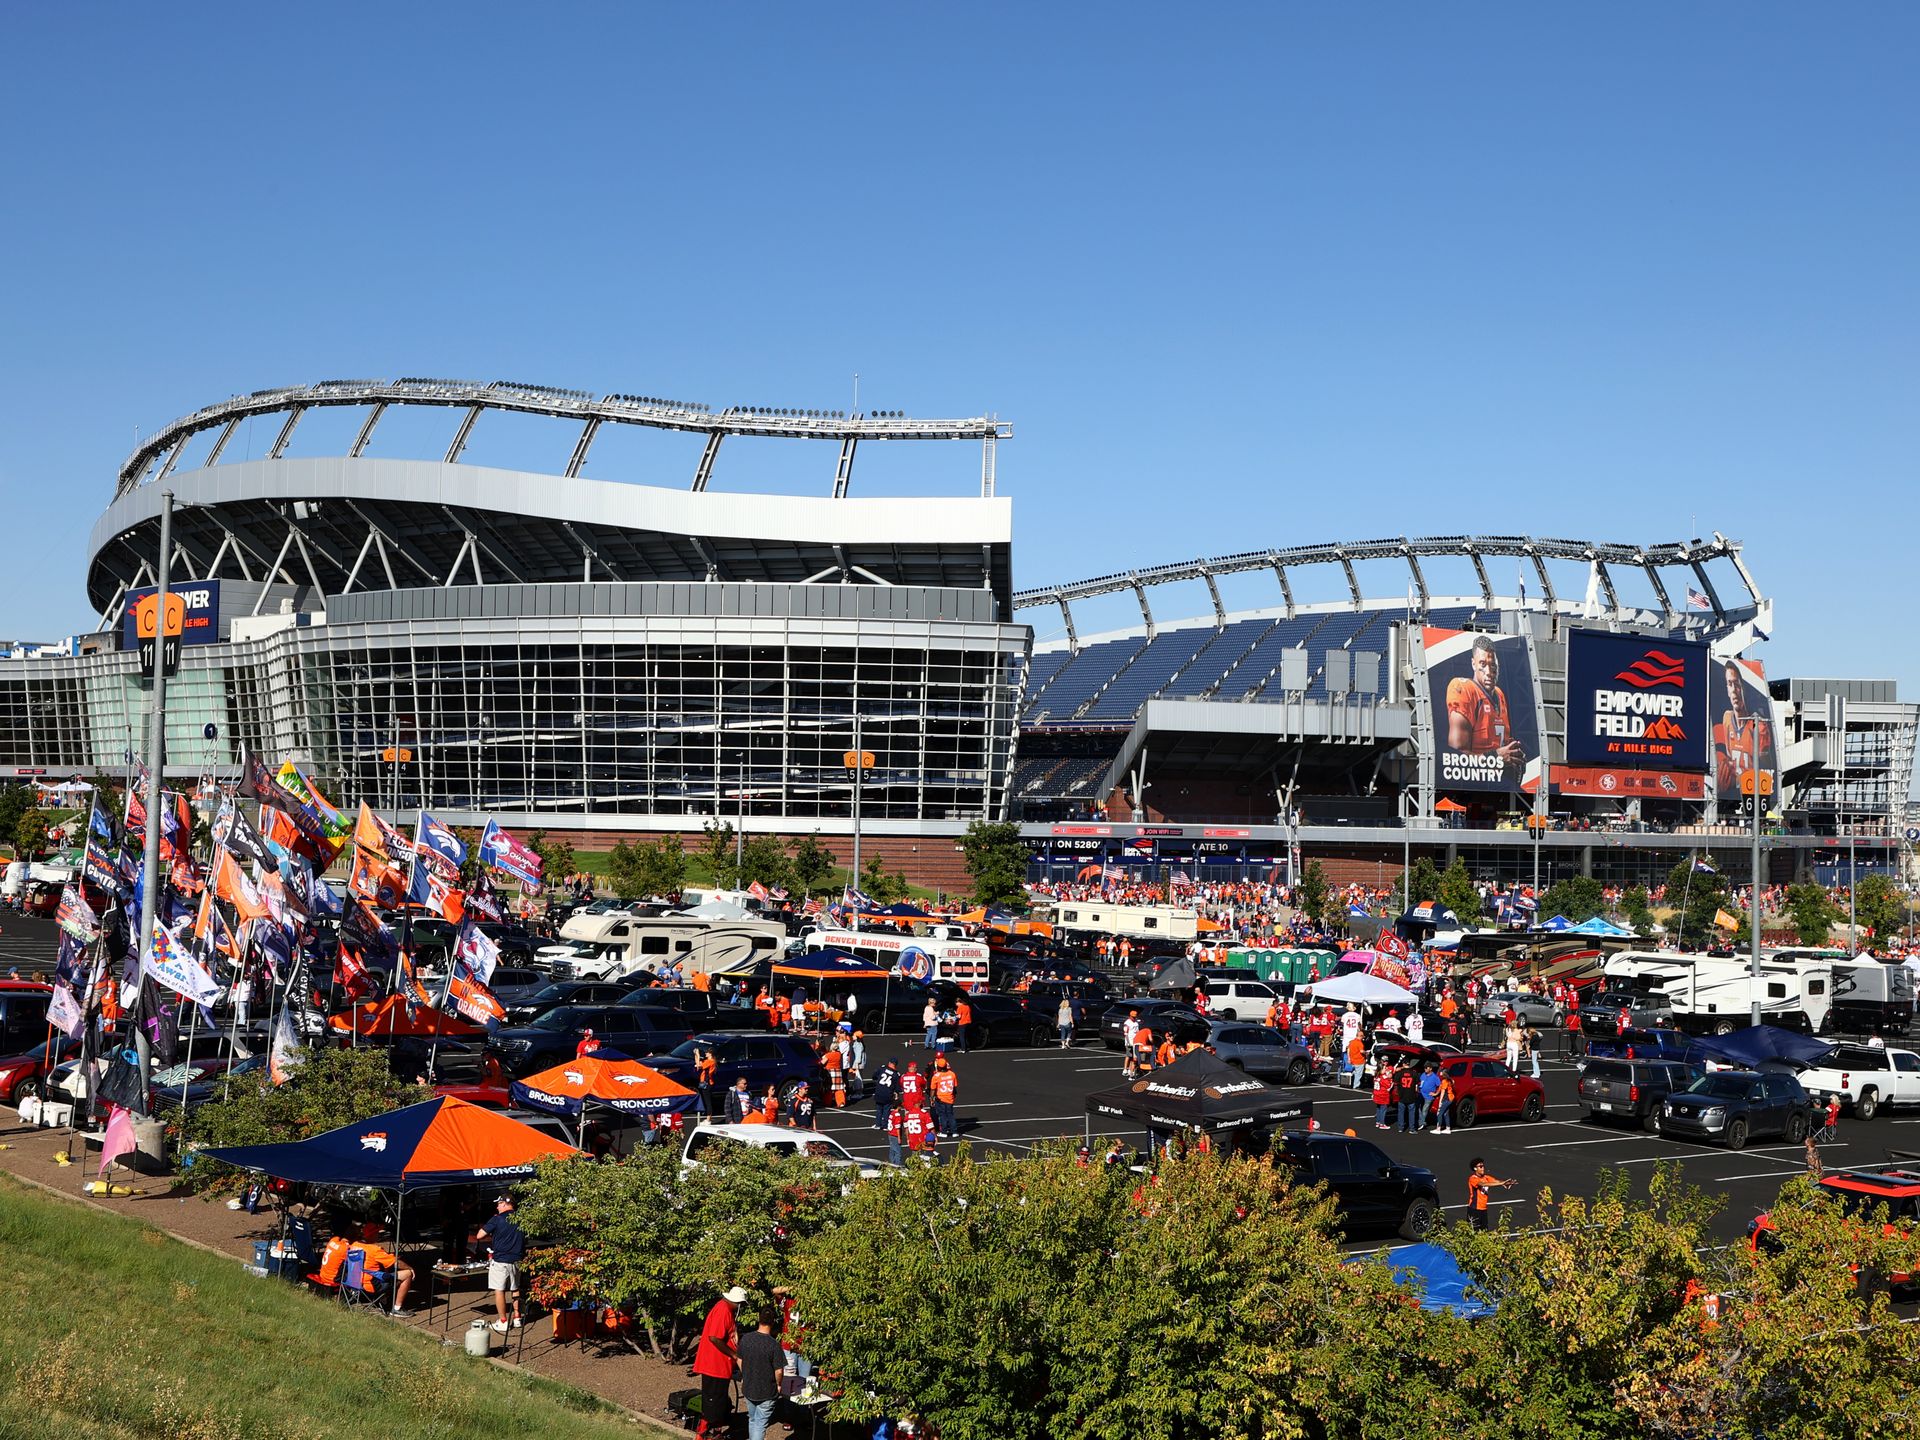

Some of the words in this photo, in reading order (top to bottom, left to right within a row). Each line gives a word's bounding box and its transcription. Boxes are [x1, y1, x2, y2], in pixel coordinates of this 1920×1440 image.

[143, 609, 154, 632] C
[166, 607, 176, 630] C
[142, 644, 154, 667] 11
[165, 642, 175, 666] 11
[1595, 688, 1684, 718] EMPOWER
[1595, 714, 1646, 738] FIELD
[1608, 742, 1620, 752] AT
[1624, 744, 1647, 754] MILE
[1650, 744, 1673, 755] HIGH
[849, 756, 856, 766] C
[863, 756, 870, 766] C
[1442, 752, 1504, 769] BRONCOS
[849, 769, 856, 780] 5
[864, 770, 870, 780] 5
[1443, 767, 1504, 782] COUNTRY
[1746, 778, 1752, 792] C
[1760, 778, 1768, 792] C
[1746, 798, 1752, 810] 6
[1760, 798, 1767, 812] 6
[1218, 843, 1228, 851] 10
[824, 936, 858, 945] DENVER
[860, 940, 900, 949] BRONCOS
[961, 950, 982, 958] SKOOL
[456, 998, 492, 1024] ORANGE
[1346, 1018, 1357, 1028] 42
[879, 1074, 892, 1088] 24
[903, 1081, 917, 1093] 54
[940, 1080, 954, 1093] 33
[1212, 1080, 1264, 1094] TimberTech
[1401, 1077, 1413, 1088] 97
[1146, 1082, 1196, 1098] TimberTech
[528, 1090, 566, 1106] BRONCOS
[611, 1098, 670, 1109] BRONCOS
[800, 1104, 812, 1116] 95
[908, 1119, 922, 1134] 85
[472, 1164, 534, 1177] BRONCOS
[322, 1248, 332, 1266] 3
